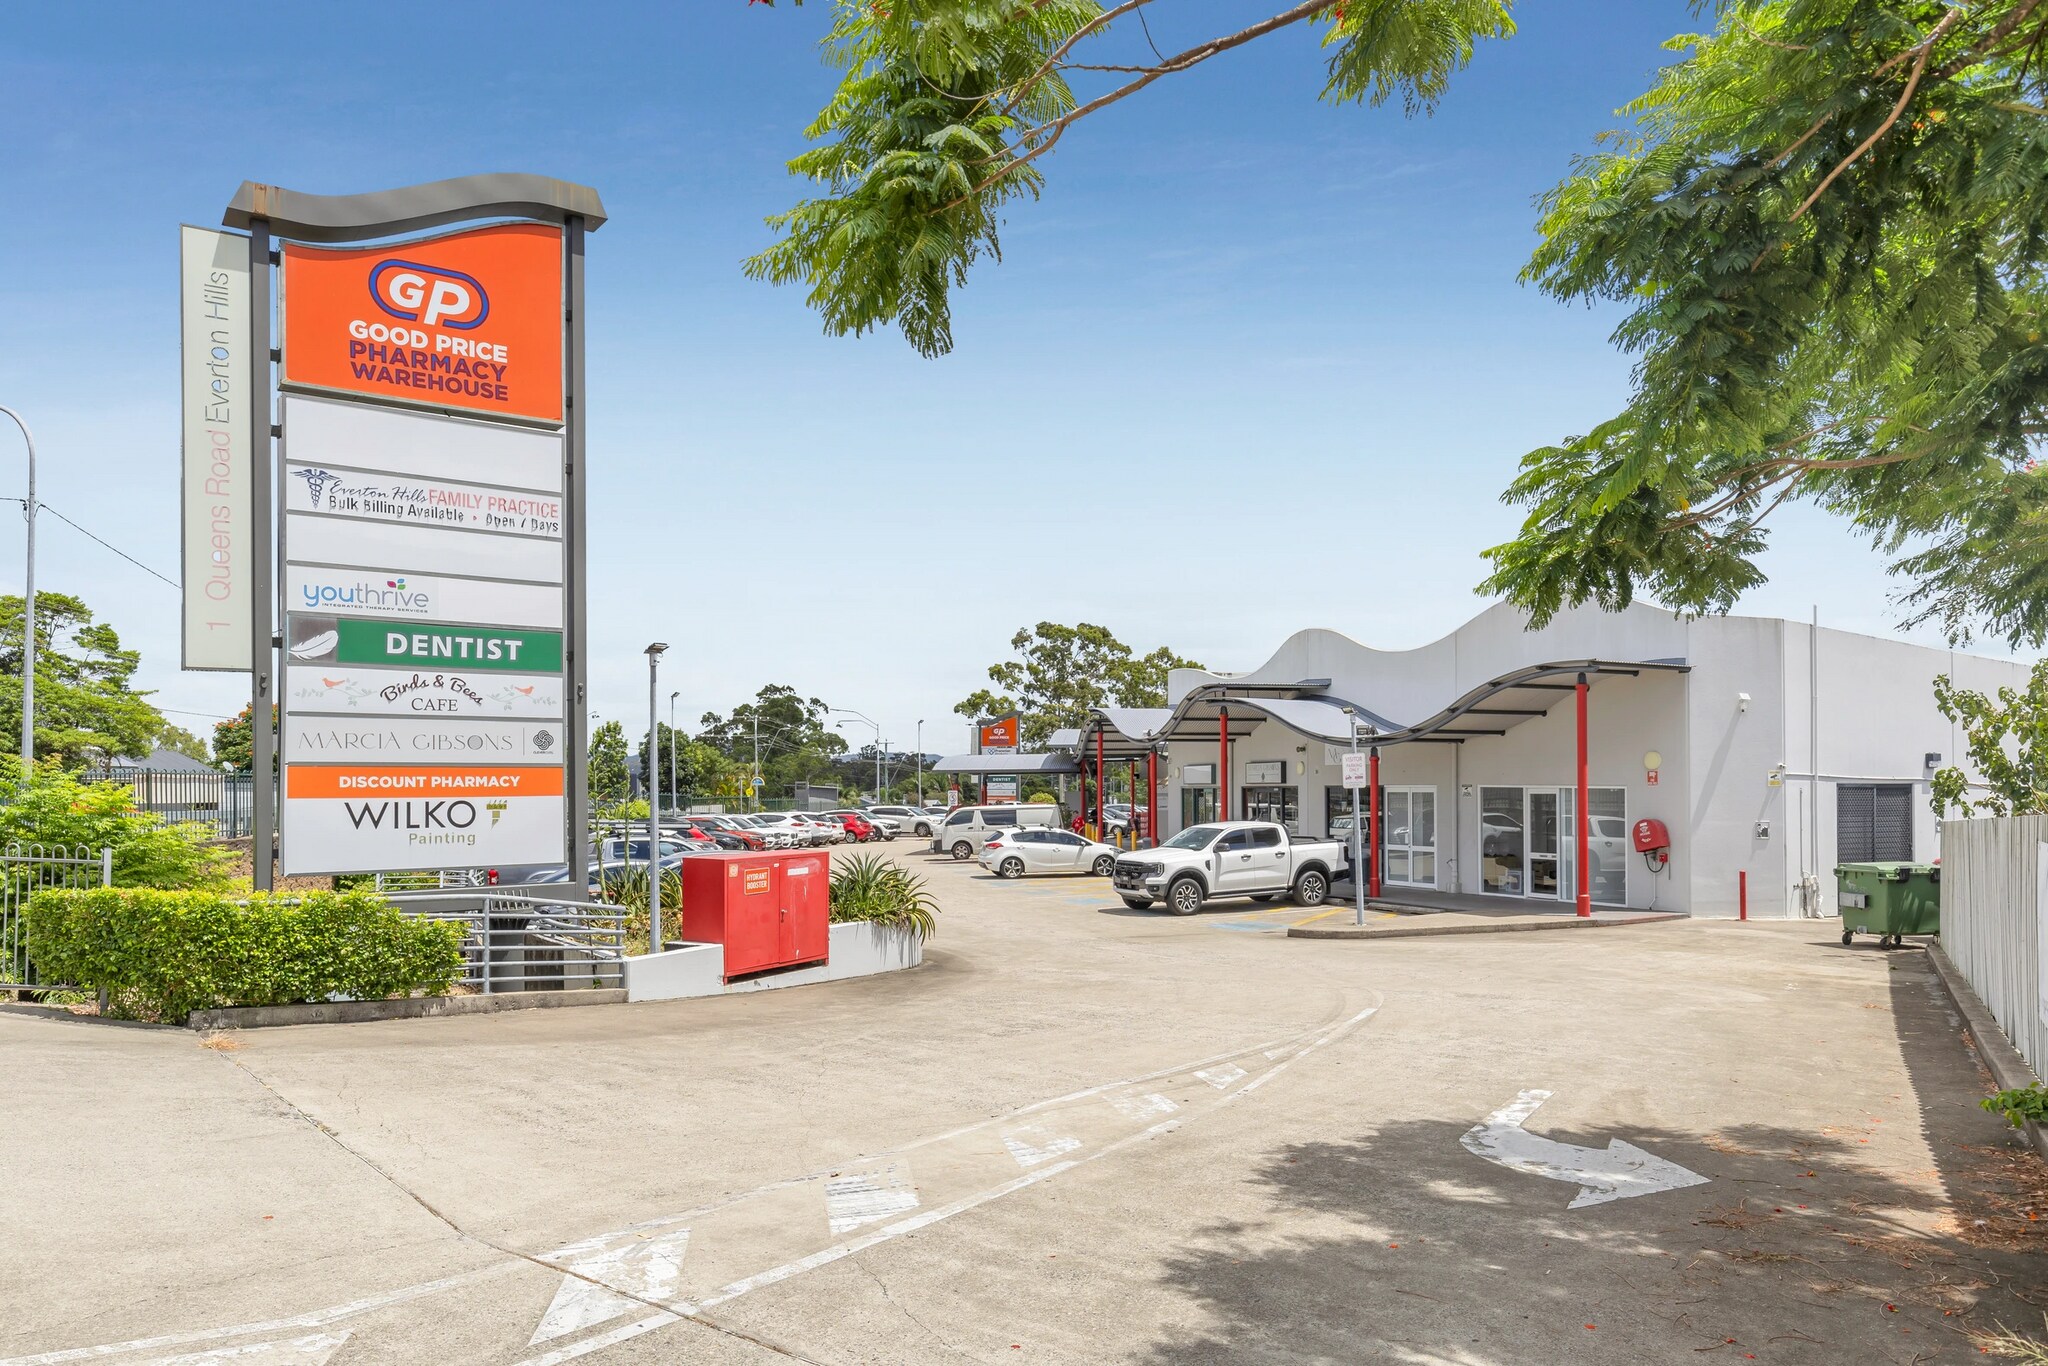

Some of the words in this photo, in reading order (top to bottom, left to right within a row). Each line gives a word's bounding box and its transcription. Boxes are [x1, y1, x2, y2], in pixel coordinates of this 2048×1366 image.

[204, 270, 229, 320] Hills
[389, 273, 471, 325] GP
[348, 319, 429, 349] GOOD
[436, 333, 508, 363] PRICE
[204, 329, 230, 424] Everton
[349, 339, 508, 382] PHARMACY
[350, 361, 509, 401] WAREHOUSE
[205, 429, 231, 497] Road
[329, 479, 389, 498] Everton
[392, 486, 428, 503] Hills
[428, 489, 483, 510] FAMILY
[488, 496, 559, 519] PRACTICE
[329, 495, 359, 511] Bulk
[364, 499, 404, 518] Billing
[408, 503, 464, 522] Available
[531, 518, 559, 534] Days
[205, 505, 231, 601] Queens
[303, 581, 429, 607] youthrive
[207, 622, 230, 630] 1
[386, 632, 523, 661] DENTIST
[380, 673, 429, 703] Birds
[433, 674, 445, 687] &
[450, 676, 483, 705] Bees
[411, 698, 458, 712] CAFE
[298, 731, 401, 750] MARCIA
[412, 733, 513, 751] GIBSONS
[338, 775, 427, 788] DISCOUNT
[431, 775, 521, 788] PHARMACY
[344, 800, 477, 830] WILKO
[409, 832, 476, 846] Painting
[746, 872, 768, 881] HYDRANT
[746, 880, 767, 890] BOOSTER
